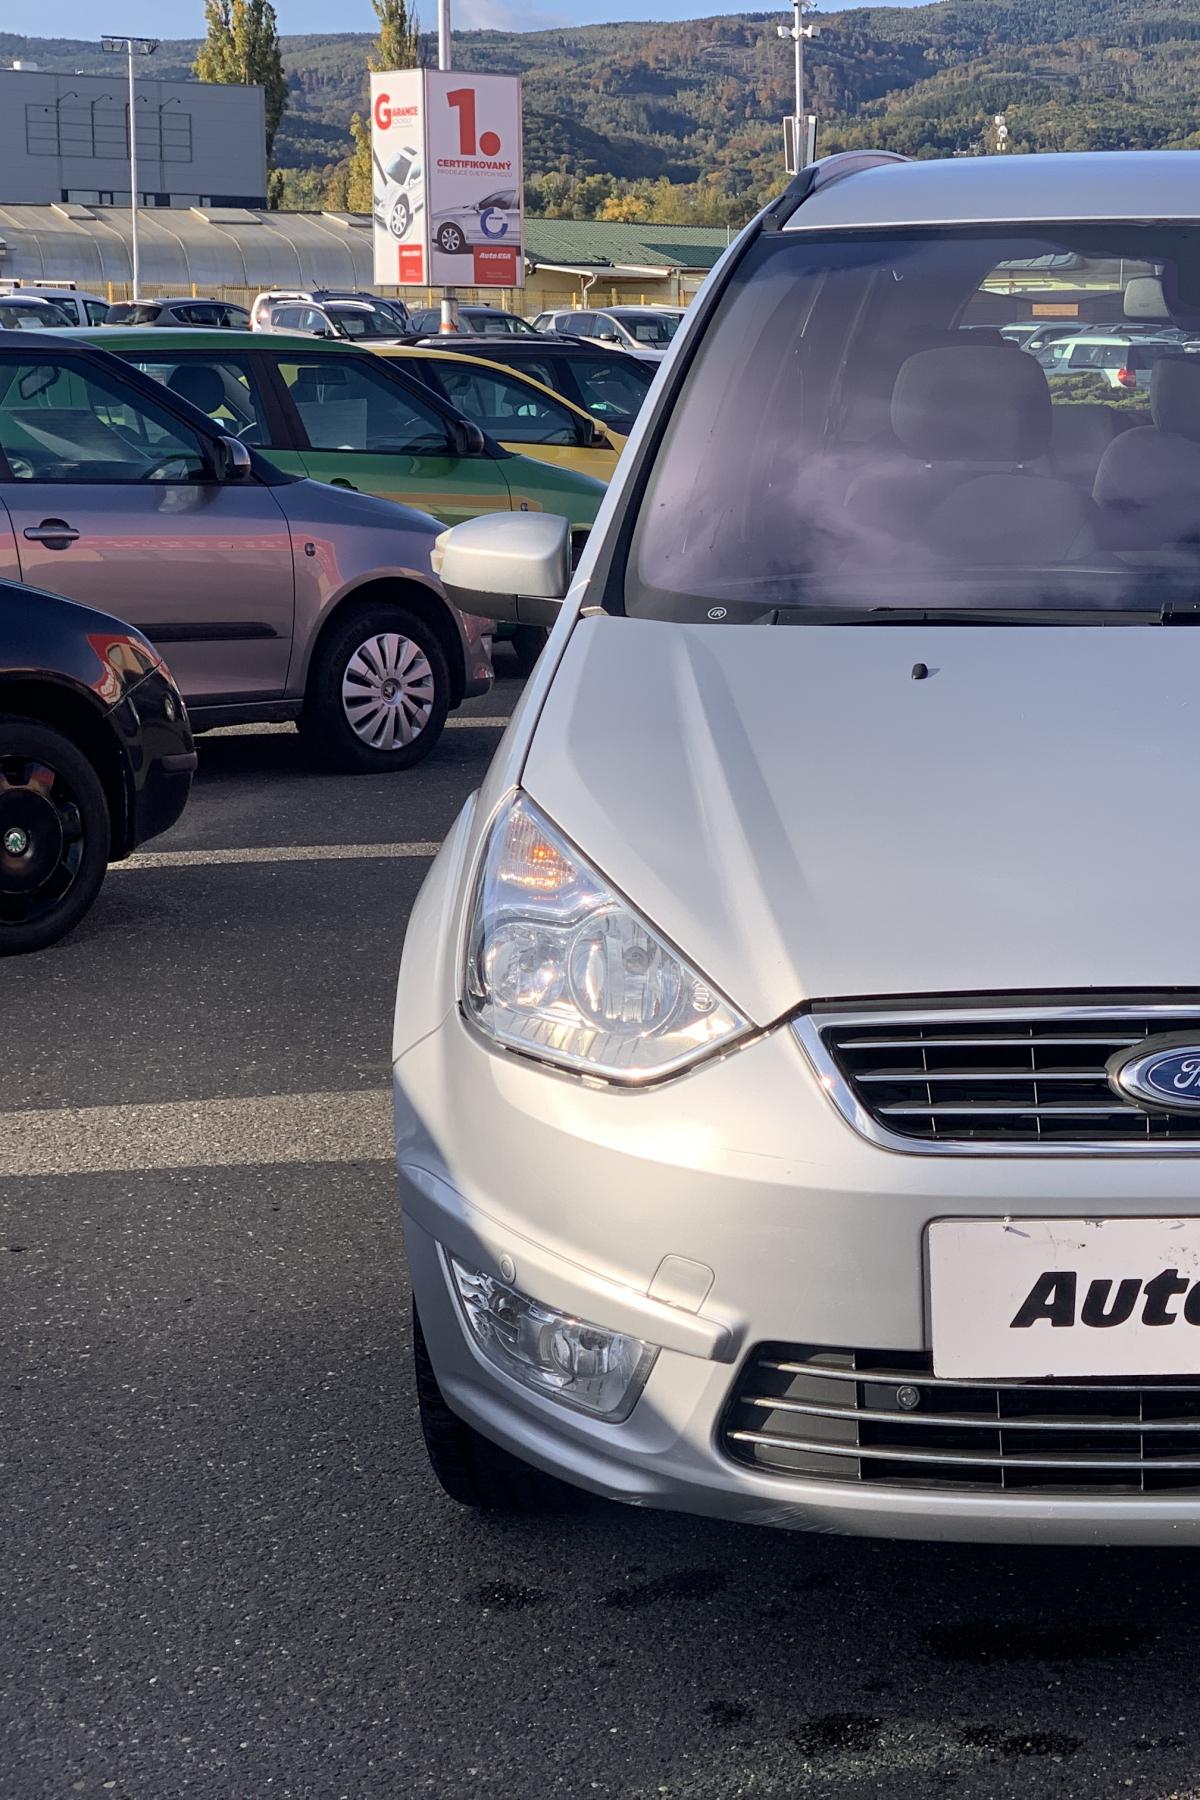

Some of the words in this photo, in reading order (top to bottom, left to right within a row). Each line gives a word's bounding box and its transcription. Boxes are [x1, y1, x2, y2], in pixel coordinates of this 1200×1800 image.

[374, 93, 418, 131] GARANCE
[446, 88, 501, 156] 1.
[437, 159, 511, 170] CERTIFIKOVANÝ
